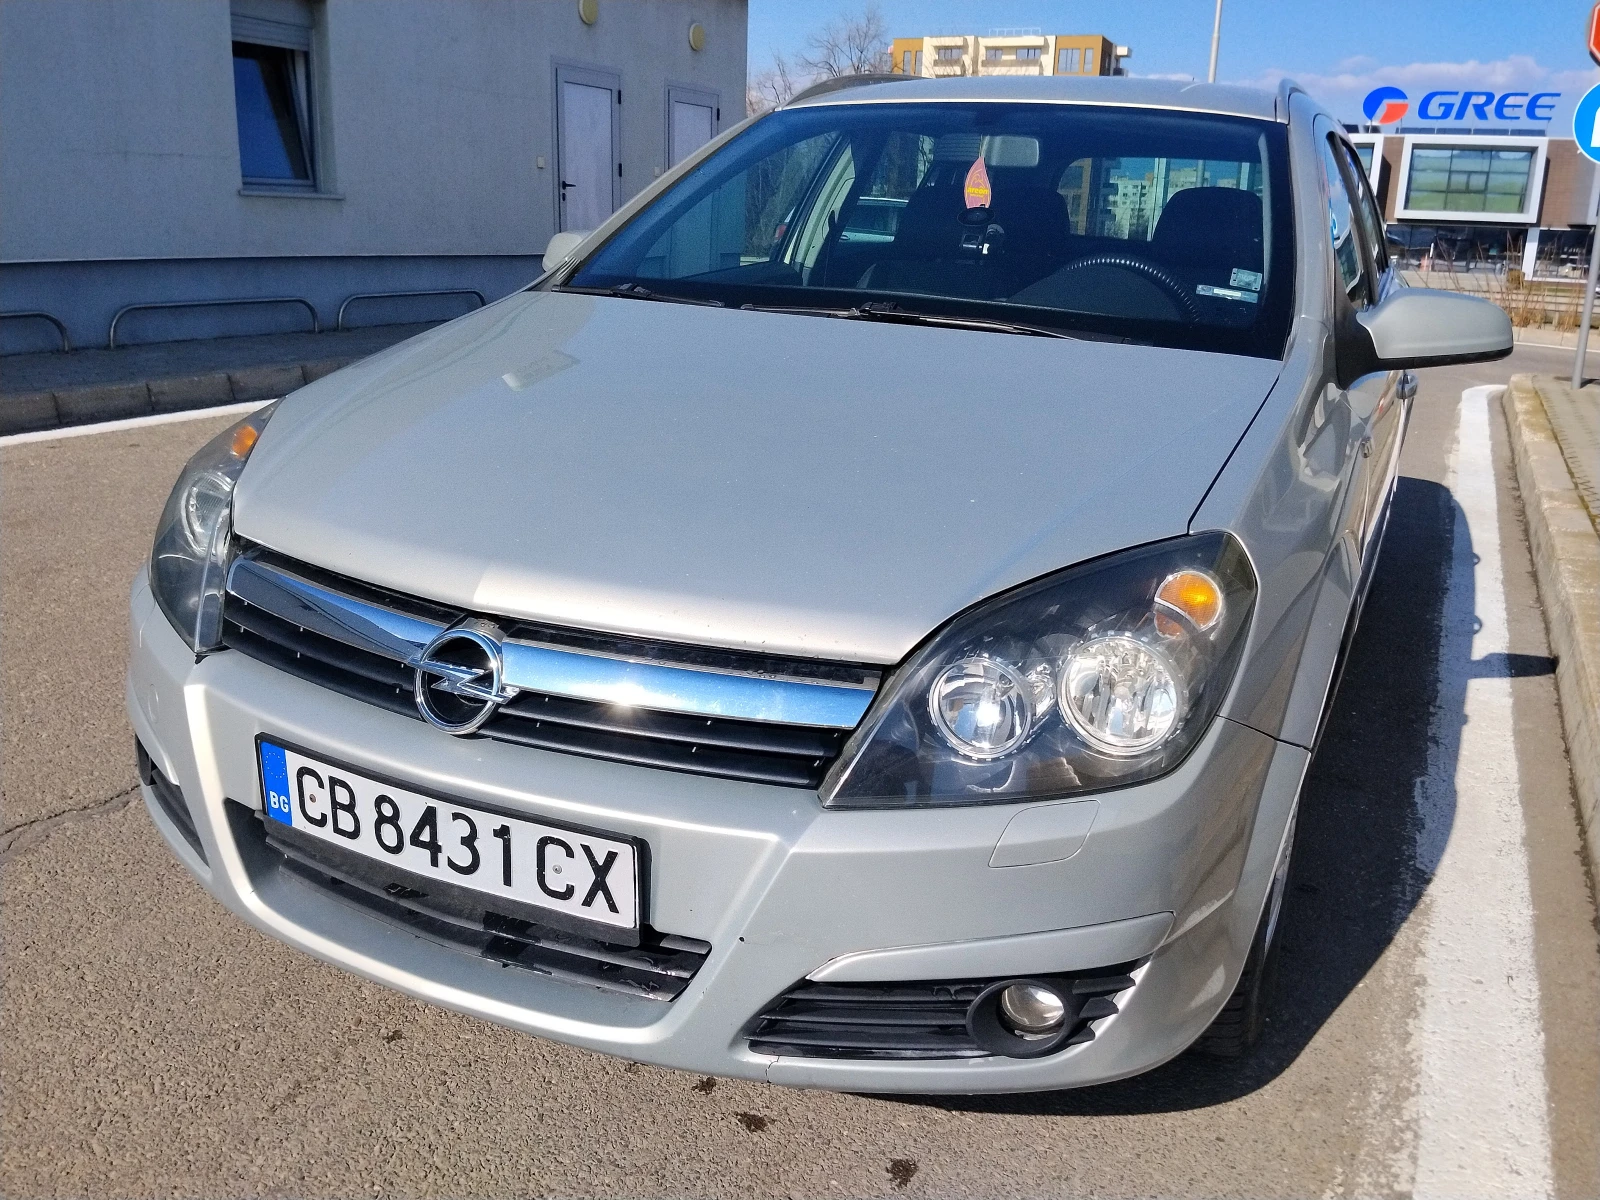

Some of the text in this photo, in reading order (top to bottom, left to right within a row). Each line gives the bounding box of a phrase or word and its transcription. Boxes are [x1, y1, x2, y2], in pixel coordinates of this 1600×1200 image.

[1417, 91, 1561, 121] GREE
[269, 790, 290, 813] BG
[296, 765, 620, 914] CB 8431 CX
